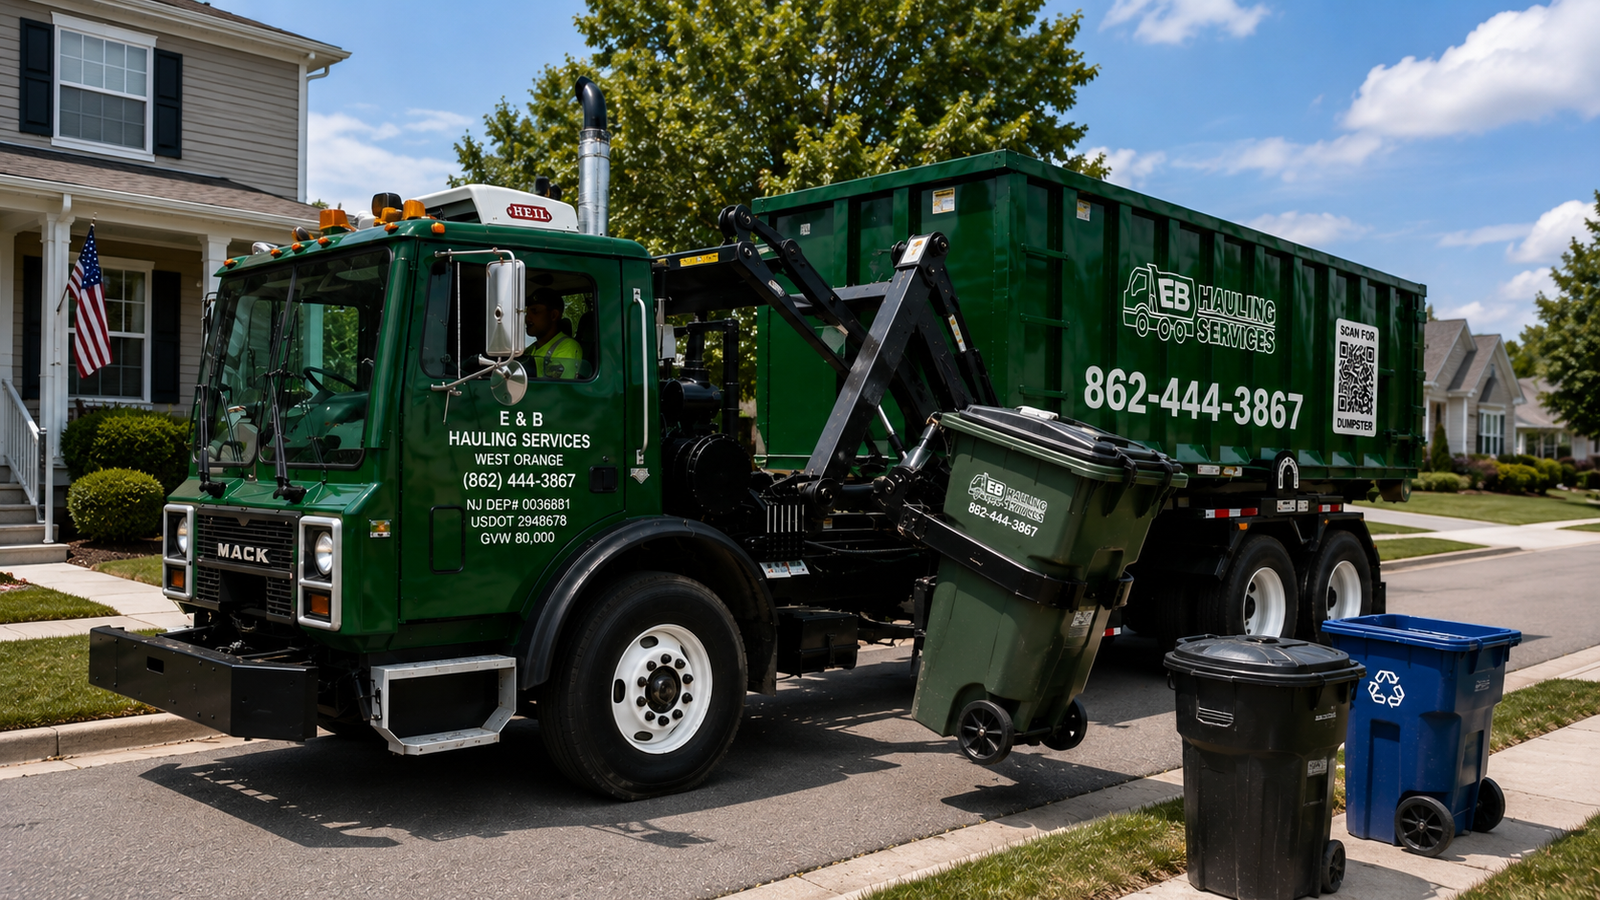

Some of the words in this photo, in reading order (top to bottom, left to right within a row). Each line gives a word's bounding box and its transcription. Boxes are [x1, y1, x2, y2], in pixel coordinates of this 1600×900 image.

[513, 206, 547, 219] HEIL
[1158, 278, 1191, 312] EB
[1199, 284, 1276, 325] HAULING
[1197, 317, 1276, 355] SERVICES
[1340, 325, 1360, 339] SCAN
[1361, 329, 1375, 342] FOR
[1084, 365, 1304, 430] 862-444-3867
[499, 410, 510, 426] E
[515, 411, 527, 427] &
[532, 411, 543, 427] B
[1337, 418, 1373, 431] DUMPSTER
[449, 430, 517, 447] HAULING
[521, 432, 591, 449] SERVICES
[474, 453, 511, 466] WEST
[513, 453, 564, 467] ORANGE
[463, 472, 503, 491] (862)
[507, 472, 576, 488] 444-3867
[986, 480, 1004, 496] EB
[466, 498, 482, 511] NJ
[486, 498, 519, 511] DEP#
[522, 498, 570, 510] 0036881
[471, 515, 514, 528] USDOT
[518, 515, 567, 527] 2948678
[480, 532, 511, 544] GVW
[515, 532, 555, 546] 80,000
[217, 542, 270, 564] MACK
